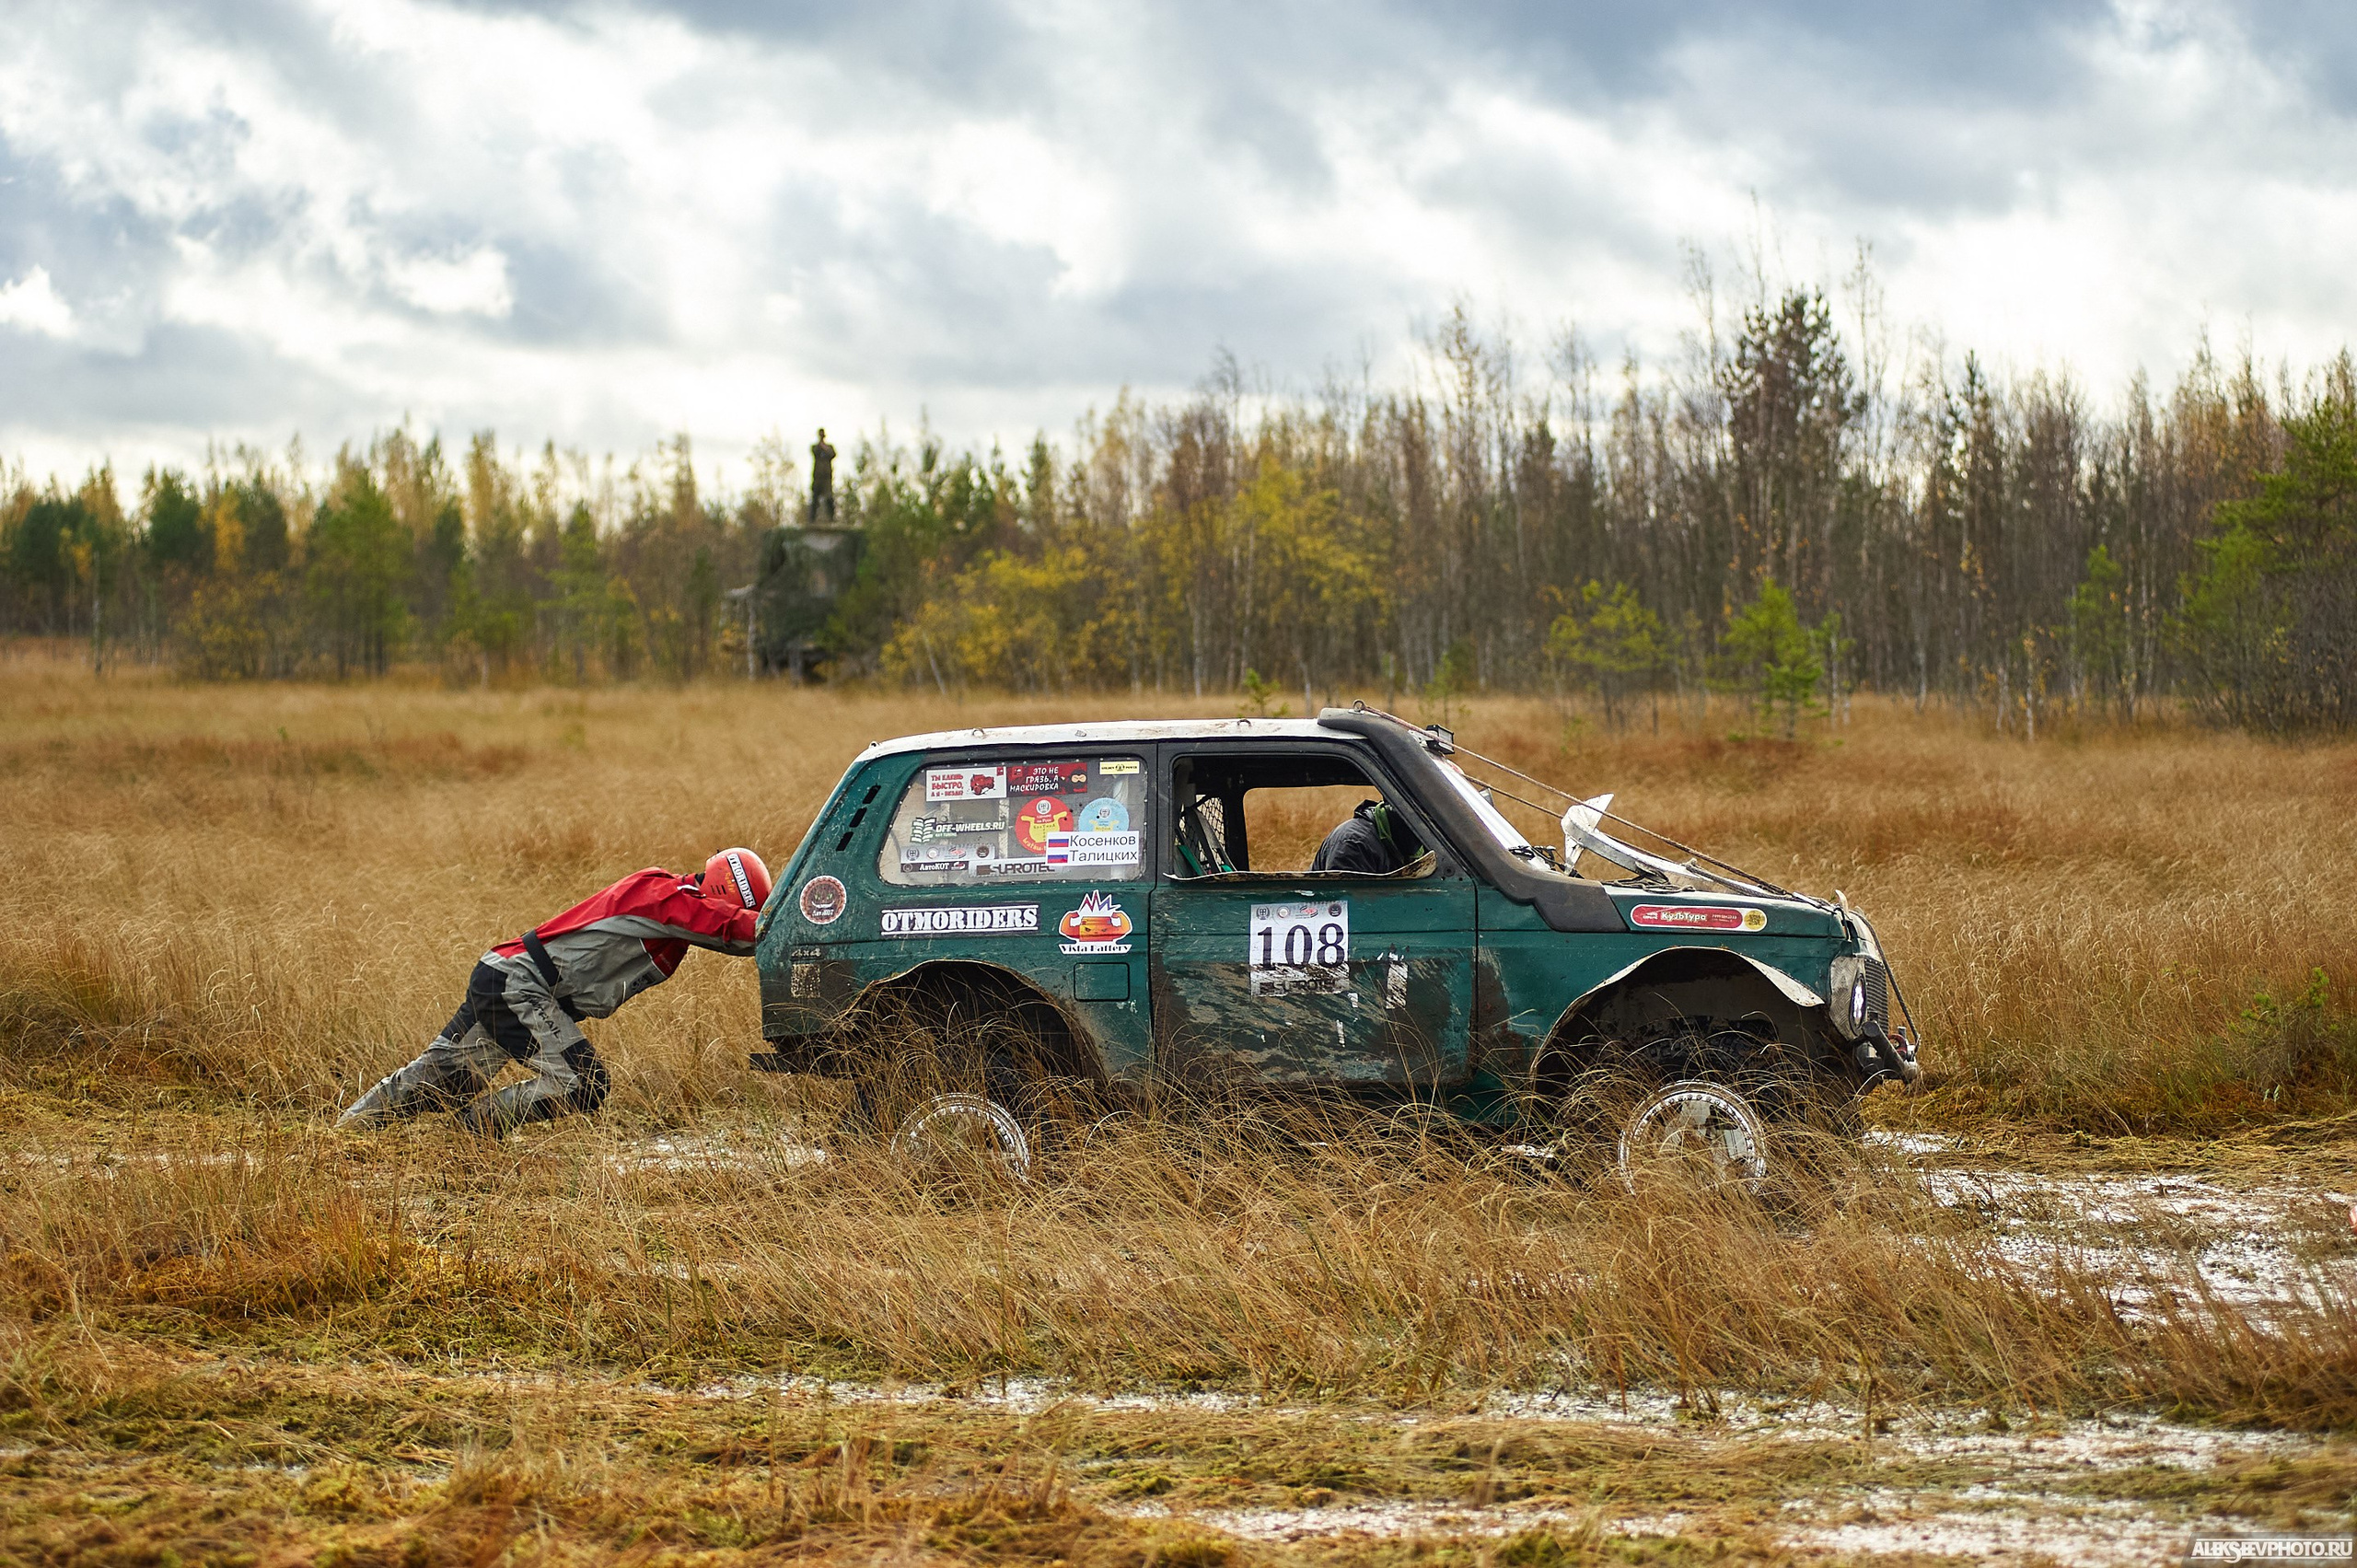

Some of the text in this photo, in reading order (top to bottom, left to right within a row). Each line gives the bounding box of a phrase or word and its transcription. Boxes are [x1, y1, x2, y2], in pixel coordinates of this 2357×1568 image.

[1033, 766, 1059, 775] ЭТО НЕ
[1026, 774, 1059, 784] ГРЯЗЬ, А
[932, 781, 964, 790] БЫСТРО,
[1009, 783, 1059, 792] МАСКИРОВКА
[935, 821, 1005, 833] OFF-WHEELS.RU
[1070, 834, 1136, 847] Косенков
[1070, 850, 1138, 863] Талицких
[919, 863, 950, 871] АвтоКОТ
[881, 908, 1038, 932] OTMORIDERS
[1258, 923, 1345, 970] 108
